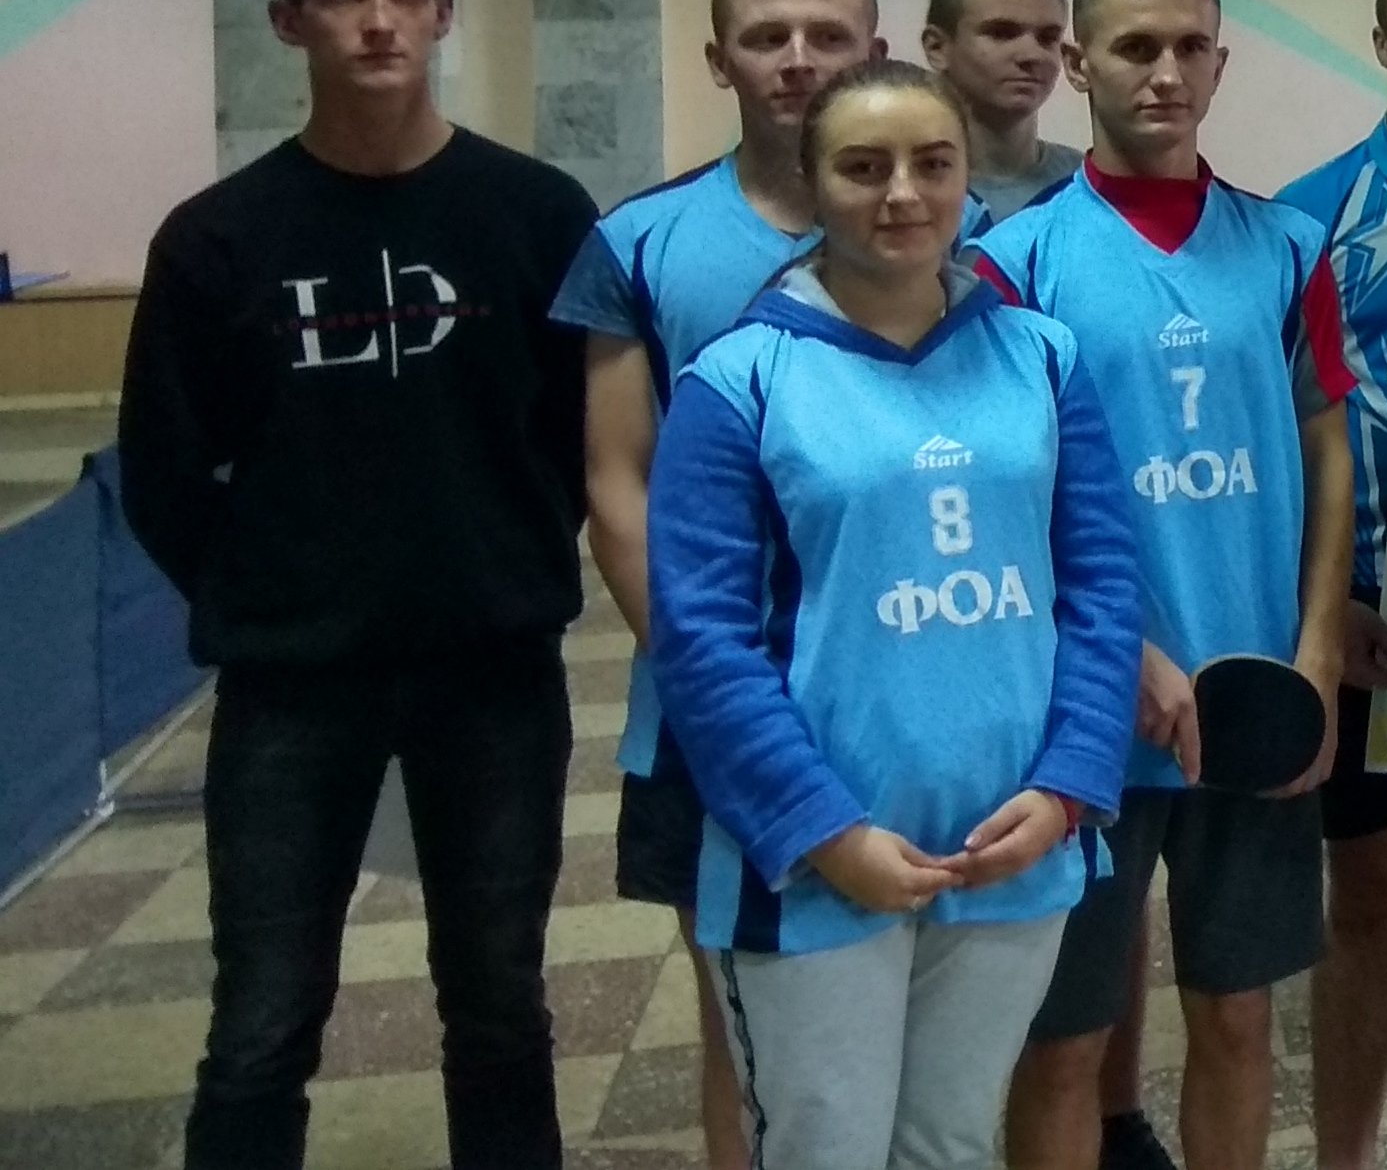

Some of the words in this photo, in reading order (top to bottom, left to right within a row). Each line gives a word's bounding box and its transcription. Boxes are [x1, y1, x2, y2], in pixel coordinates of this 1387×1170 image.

[1158, 330, 1209, 349] Start
[1170, 365, 1206, 432] 7
[913, 450, 974, 469] Start
[1133, 447, 1258, 505] ФОА
[930, 485, 974, 557] 8
[877, 565, 1034, 635] ФОА
